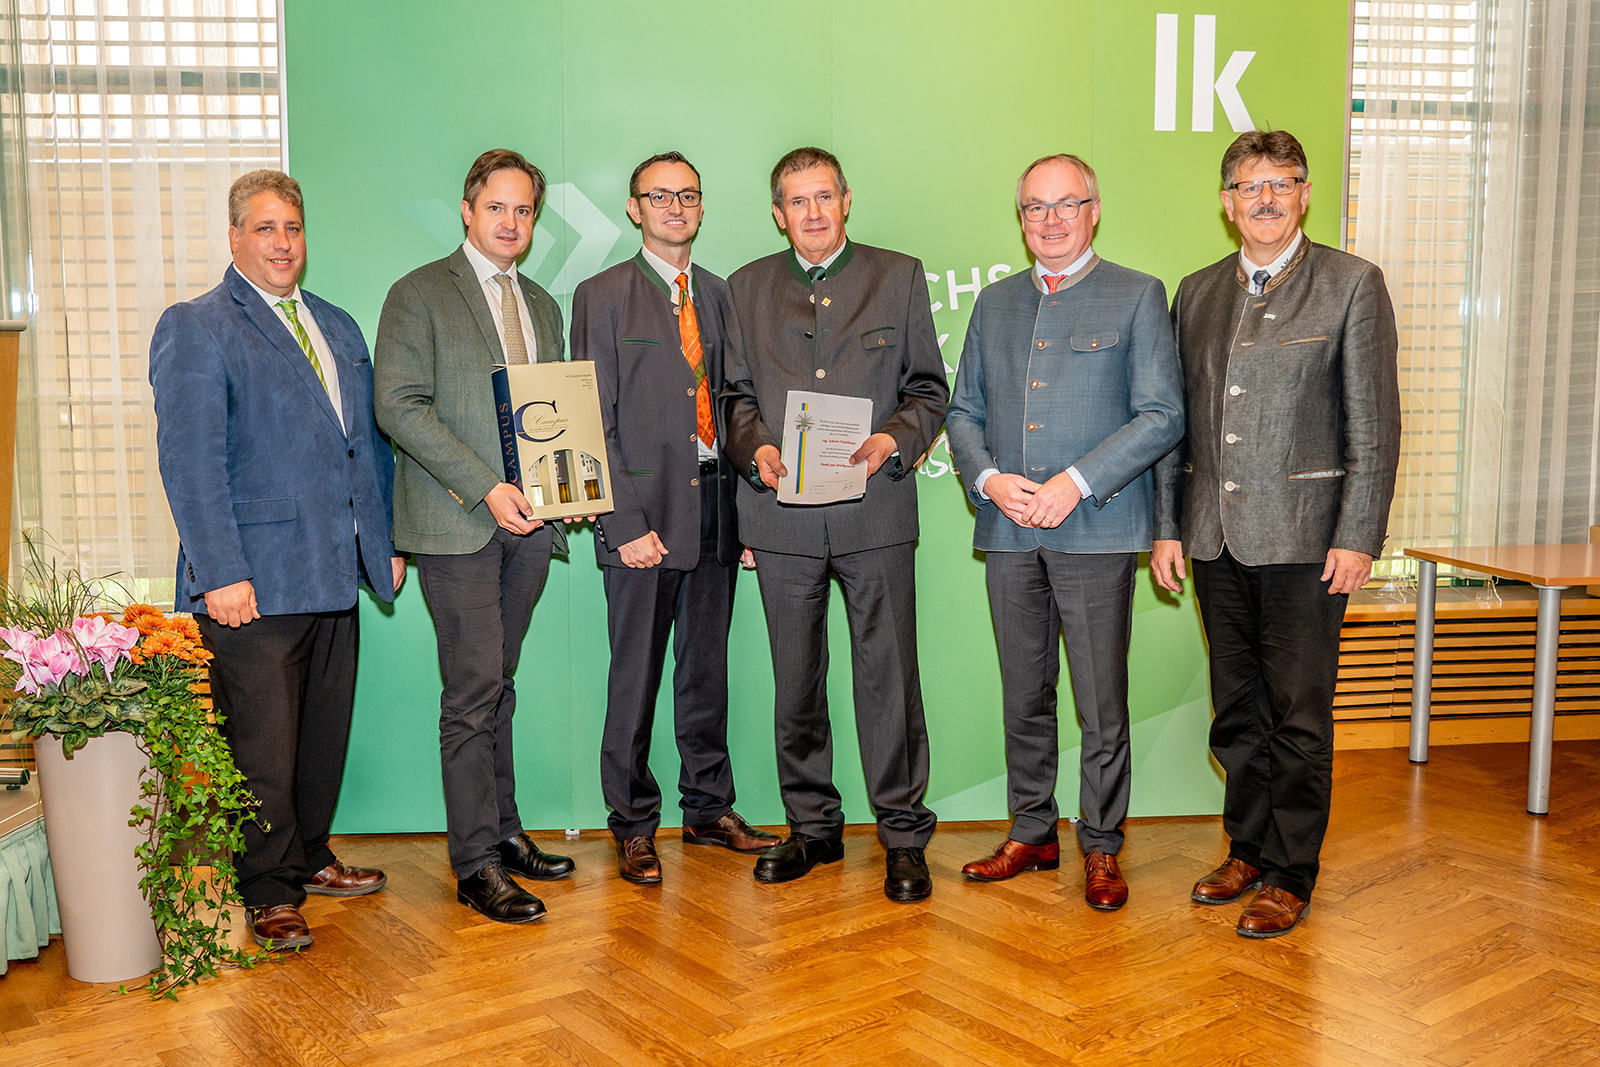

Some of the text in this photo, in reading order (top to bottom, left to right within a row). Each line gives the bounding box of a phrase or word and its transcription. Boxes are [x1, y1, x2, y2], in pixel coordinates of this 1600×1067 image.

[1154, 13, 1257, 132] lk
[499, 402, 519, 483] CAMPUS
[533, 414, 569, 427] Campus
